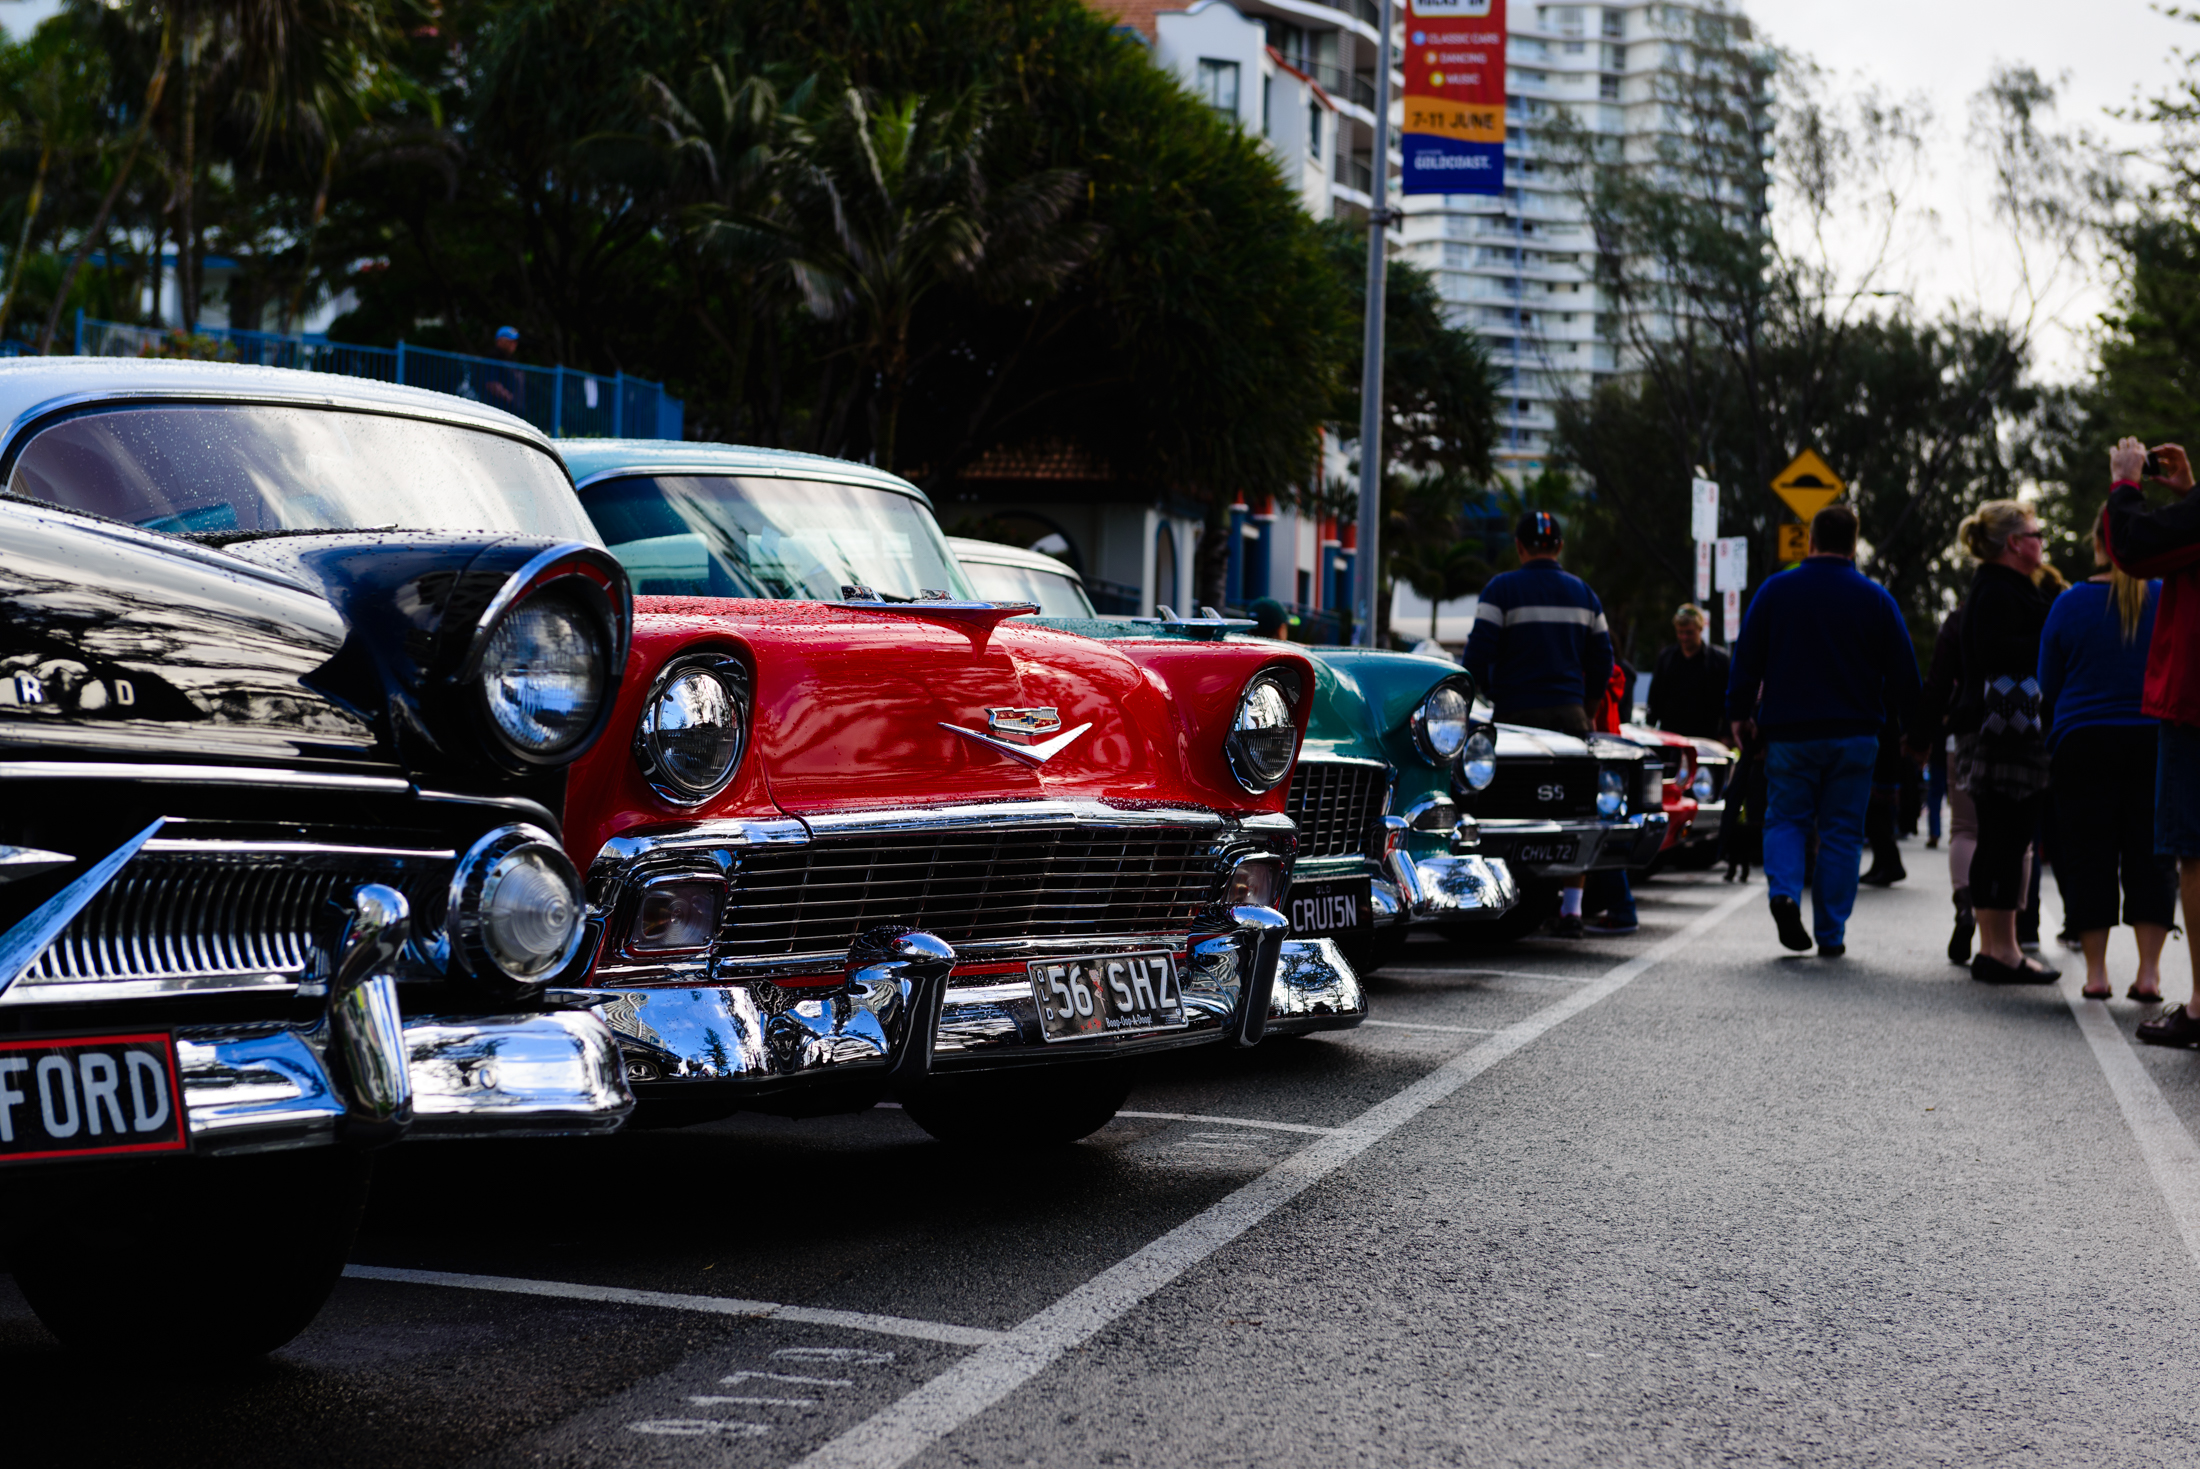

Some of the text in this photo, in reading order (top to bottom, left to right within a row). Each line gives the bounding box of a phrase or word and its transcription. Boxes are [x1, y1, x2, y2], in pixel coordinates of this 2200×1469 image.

[1412, 111, 1494, 129] 7-11 JUNE
[1537, 784, 1565, 801] SS
[1315, 885, 1331, 894] QLD
[1048, 958, 1178, 1018] 56 SHZ
[0, 1050, 170, 1142] FORD
